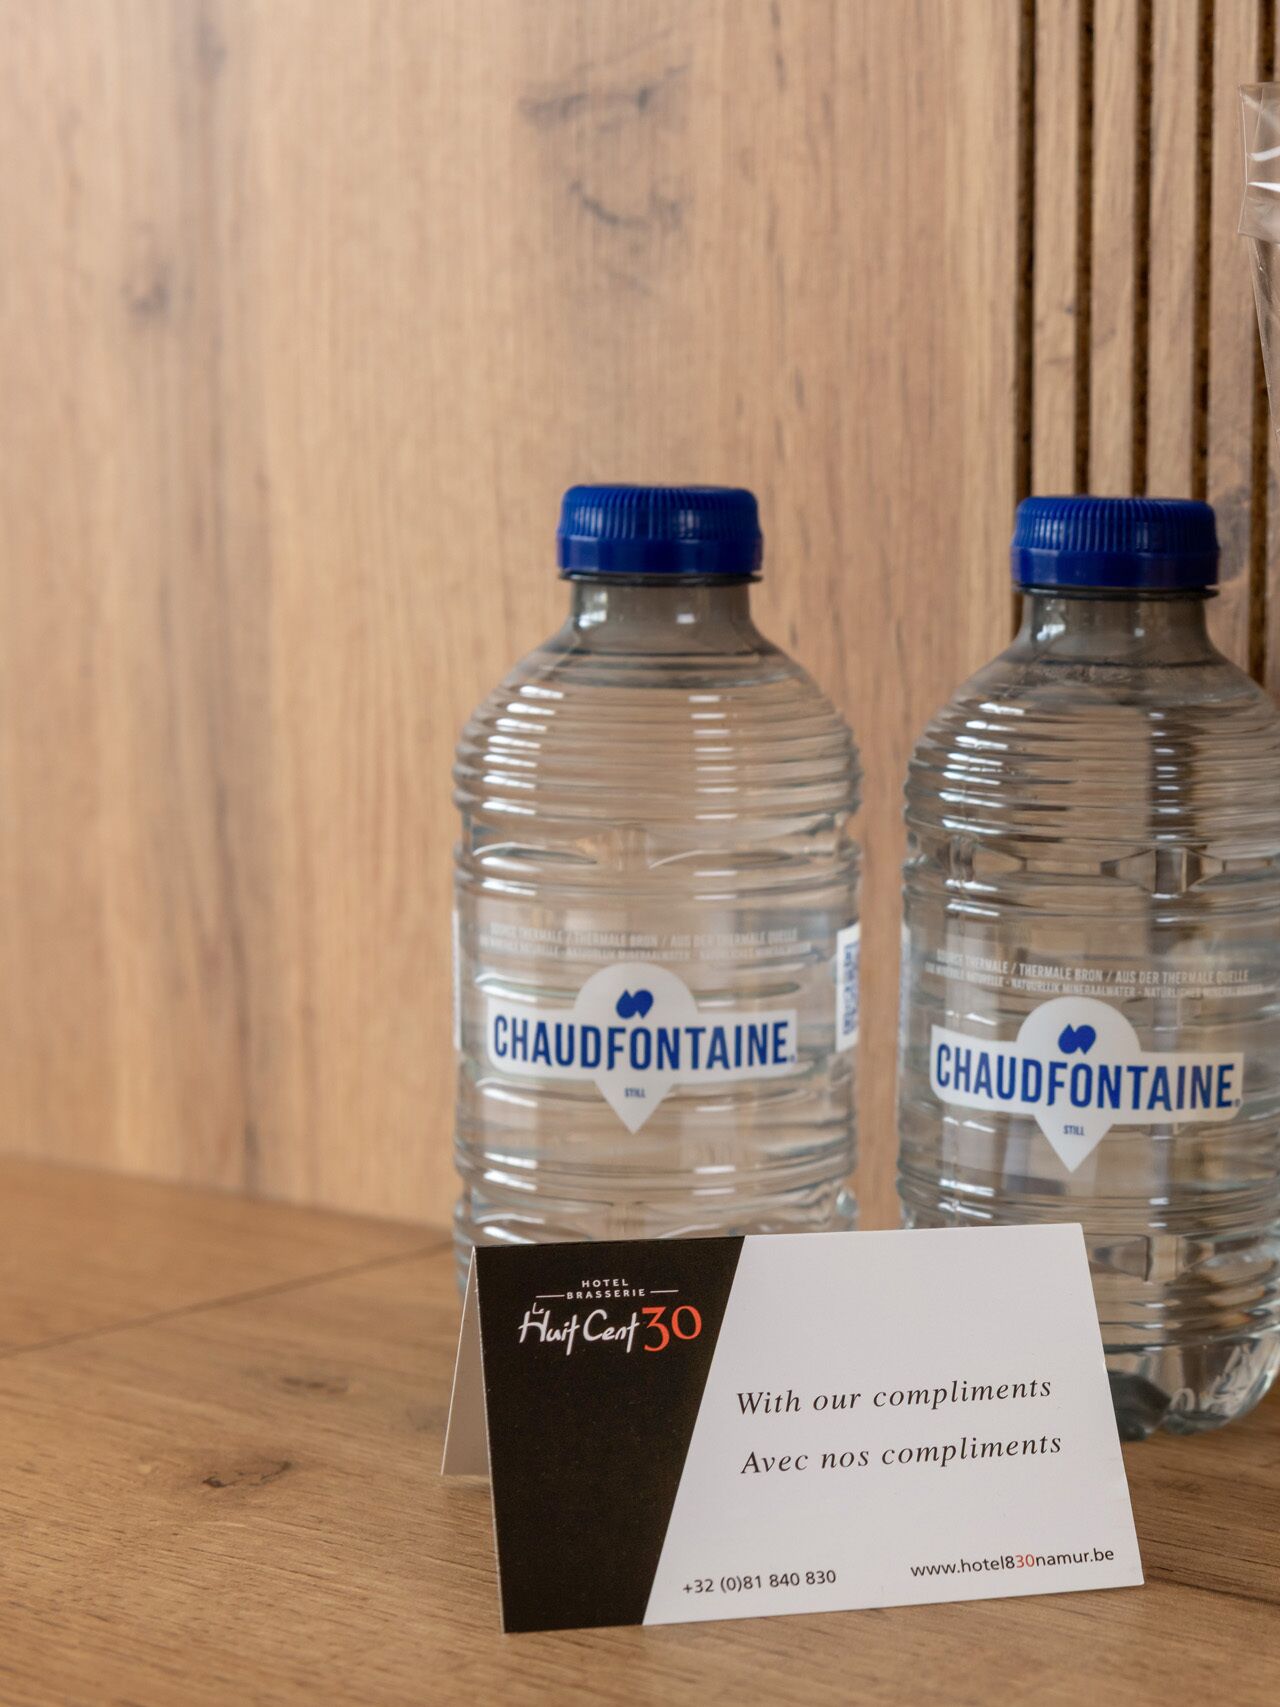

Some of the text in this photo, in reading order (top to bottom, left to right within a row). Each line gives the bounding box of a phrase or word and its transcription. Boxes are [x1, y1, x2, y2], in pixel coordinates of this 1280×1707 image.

[1019, 962, 1073, 980] THERMALE
[1075, 967, 1103, 981] BRON
[1115, 969, 1136, 983] AUS
[1139, 970, 1160, 984] DER
[493, 1014, 790, 1071] CHAUDFONTAINE
[936, 1043, 1234, 1111] CHAUDFONTAINE
[1063, 1124, 1085, 1136] STILL
[566, 1288, 646, 1299] BRASSERIE
[582, 1278, 629, 1288] HOTEL
[518, 1310, 580, 1356] Huit
[737, 1379, 1051, 1415] With our compliments
[741, 1434, 1062, 1474] Avec nos compliments
[910, 1548, 1115, 1577] www.hotel830namur.be
[683, 1569, 837, 1594] +32 (0)81 840 830
